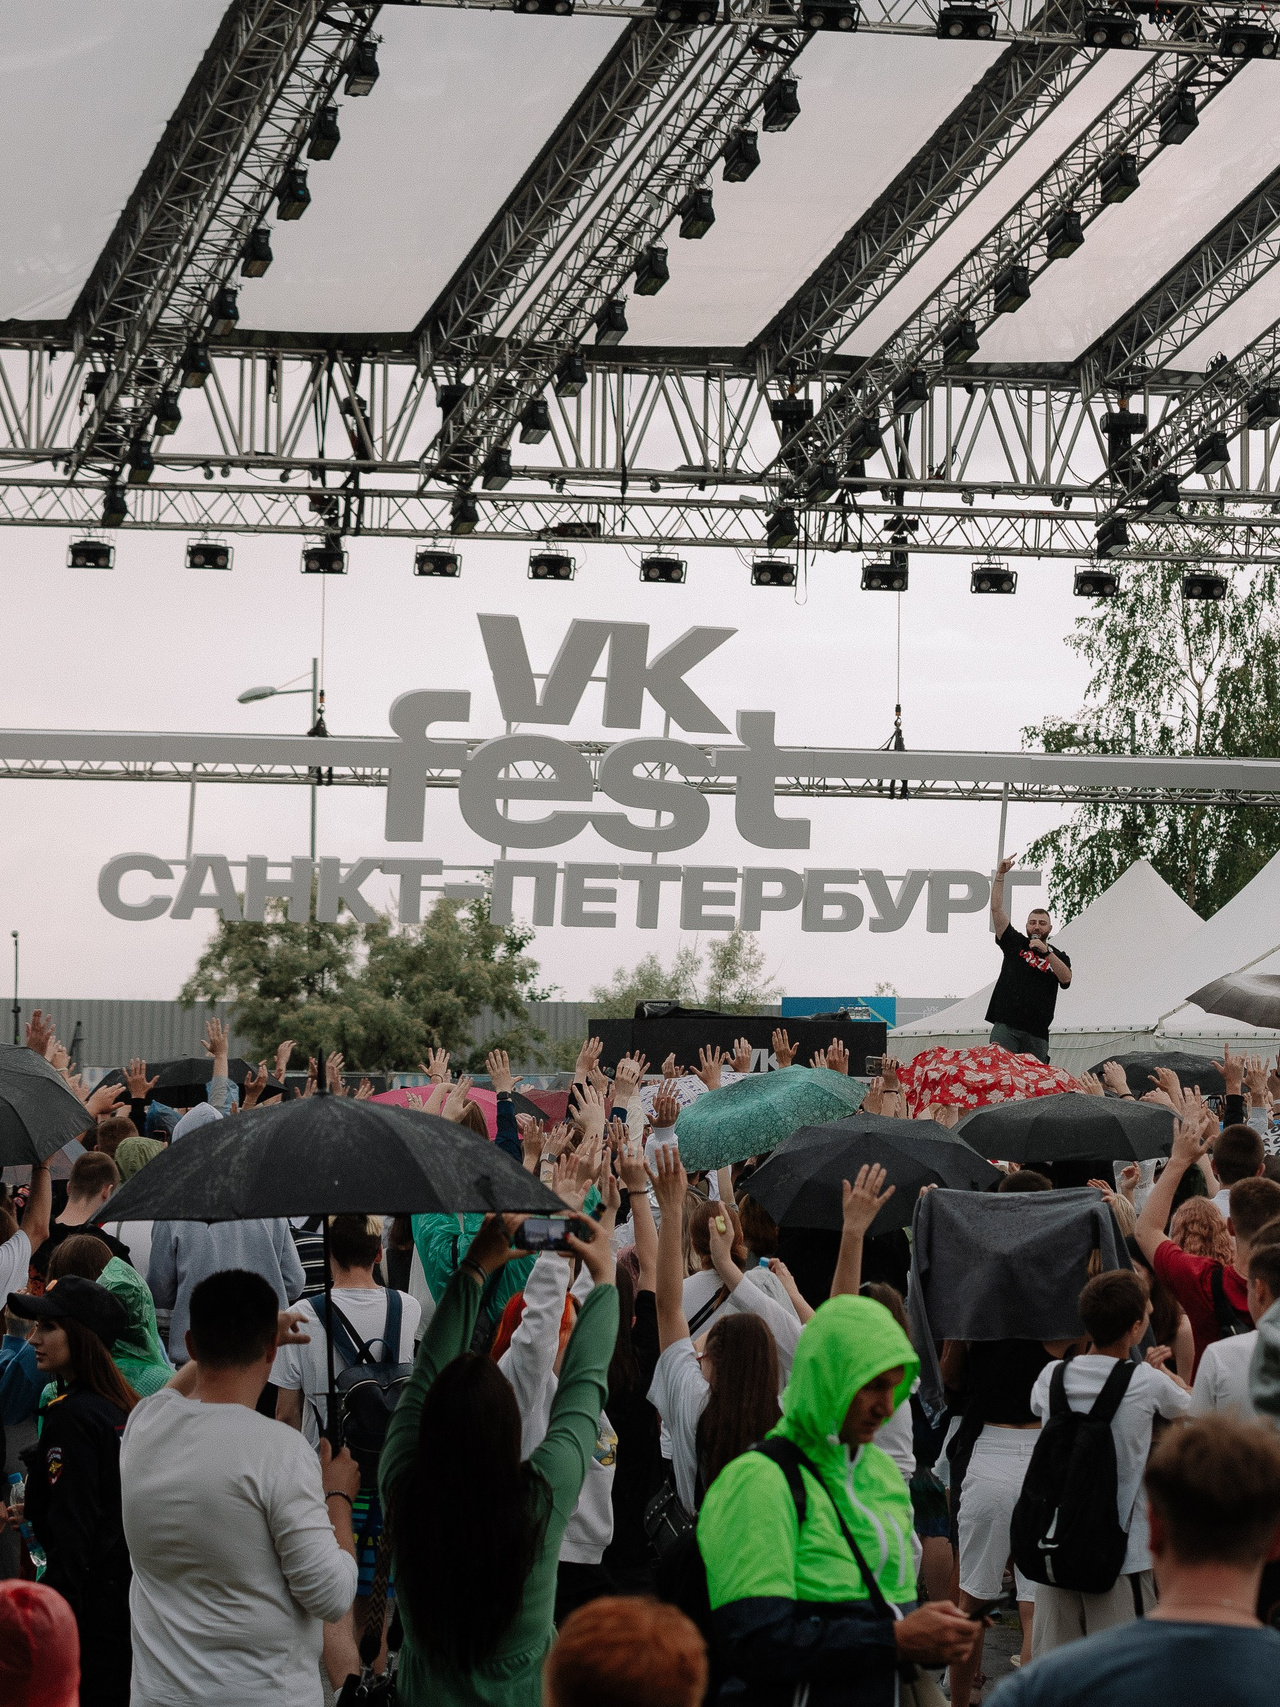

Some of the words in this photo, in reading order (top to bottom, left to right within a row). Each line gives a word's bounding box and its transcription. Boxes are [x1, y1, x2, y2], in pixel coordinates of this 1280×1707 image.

[476, 612, 739, 734] VK
[384, 688, 811, 853] fest
[98, 851, 1042, 935] САНКТ-ПЕТЕРБУРГ
